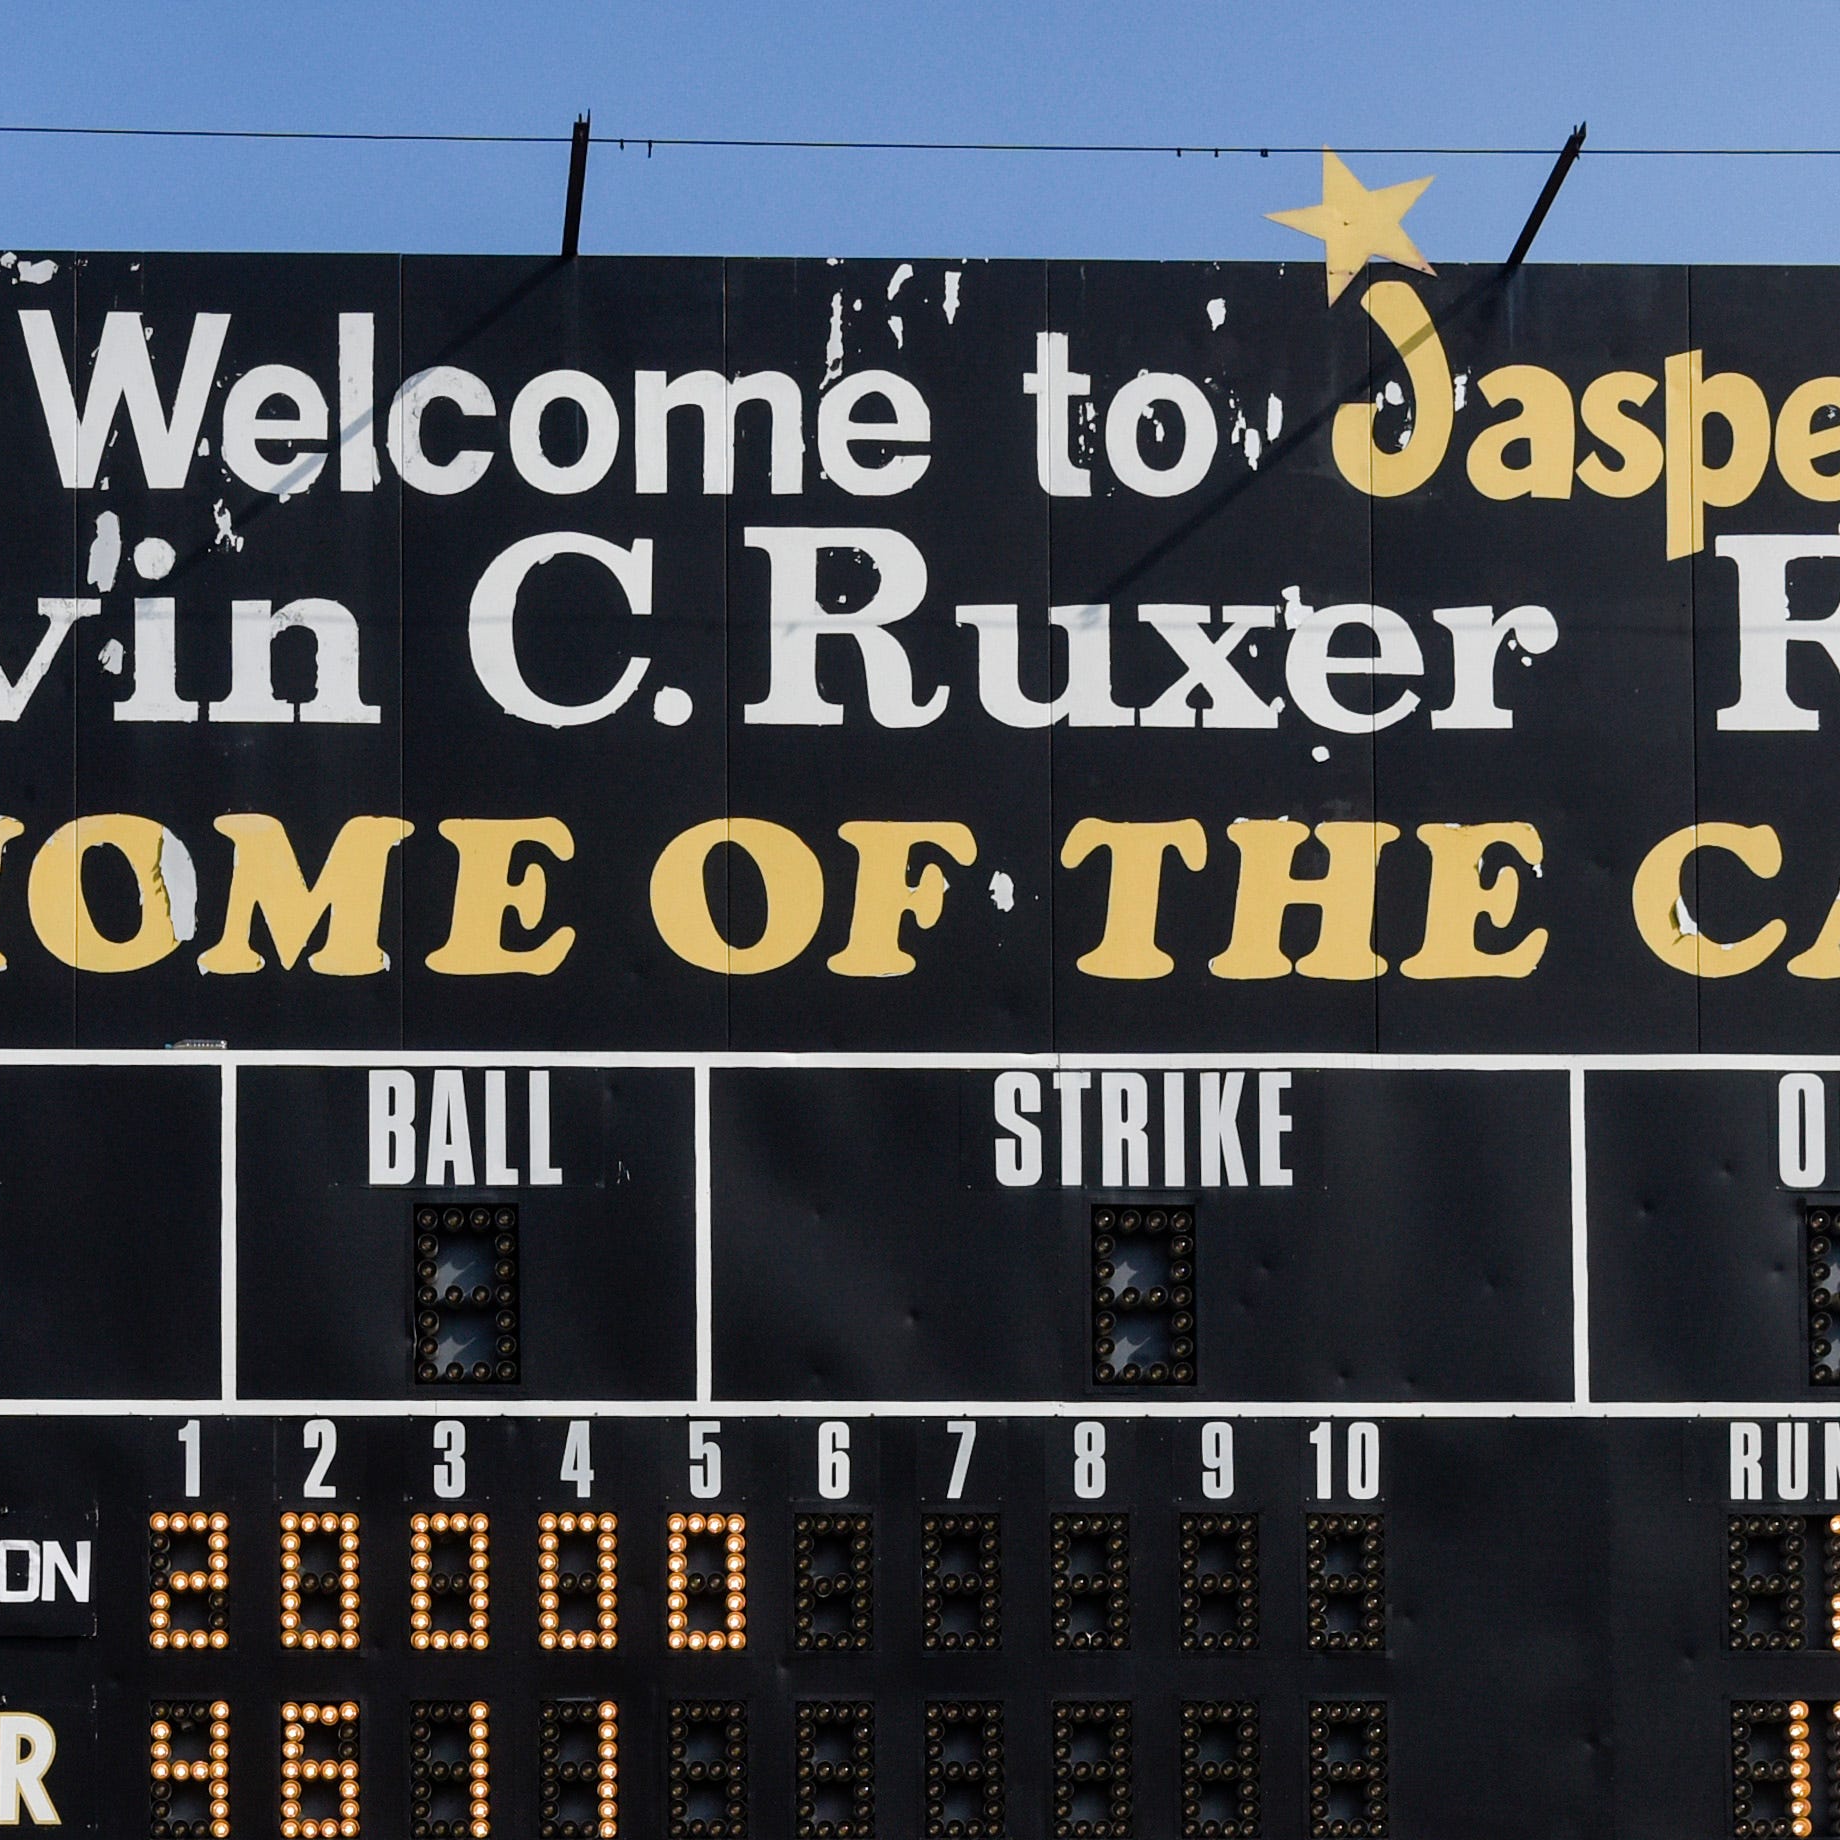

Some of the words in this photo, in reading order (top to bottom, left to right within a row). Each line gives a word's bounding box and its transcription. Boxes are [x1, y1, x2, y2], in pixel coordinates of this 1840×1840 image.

[18, 310, 932, 497] Welcome
[1023, 331, 1219, 499] to
[467, 530, 695, 727] C.
[743, 525, 1558, 733] Ruxer
[649, 816, 980, 977] OF
[1060, 817, 1548, 981] THE
[368, 1068, 563, 1187] BALL
[993, 1071, 1294, 1187] STRIKE
[178, 1419, 201, 1498] 1
[302, 1419, 338, 1499] 2
[432, 1419, 467, 1499] 3
[559, 1419, 595, 1499] 4
[688, 1420, 722, 1499] 5
[817, 1421, 851, 1499] 6
[946, 1421, 977, 1499] 7
[1074, 1421, 1107, 1499] 8
[1201, 1422, 1235, 1499] 9
[1309, 1422, 1379, 1499] 10
[149, 1511, 228, 1649] 2
[280, 1511, 360, 1649] 0
[411, 1512, 489, 1650] 0
[539, 1512, 619, 1650] 0
[667, 1513, 745, 1650] 0
[150, 1701, 229, 1839] 4
[281, 1701, 360, 1840] 6
[470, 1701, 491, 1839] 1
[599, 1701, 619, 1840] 1
